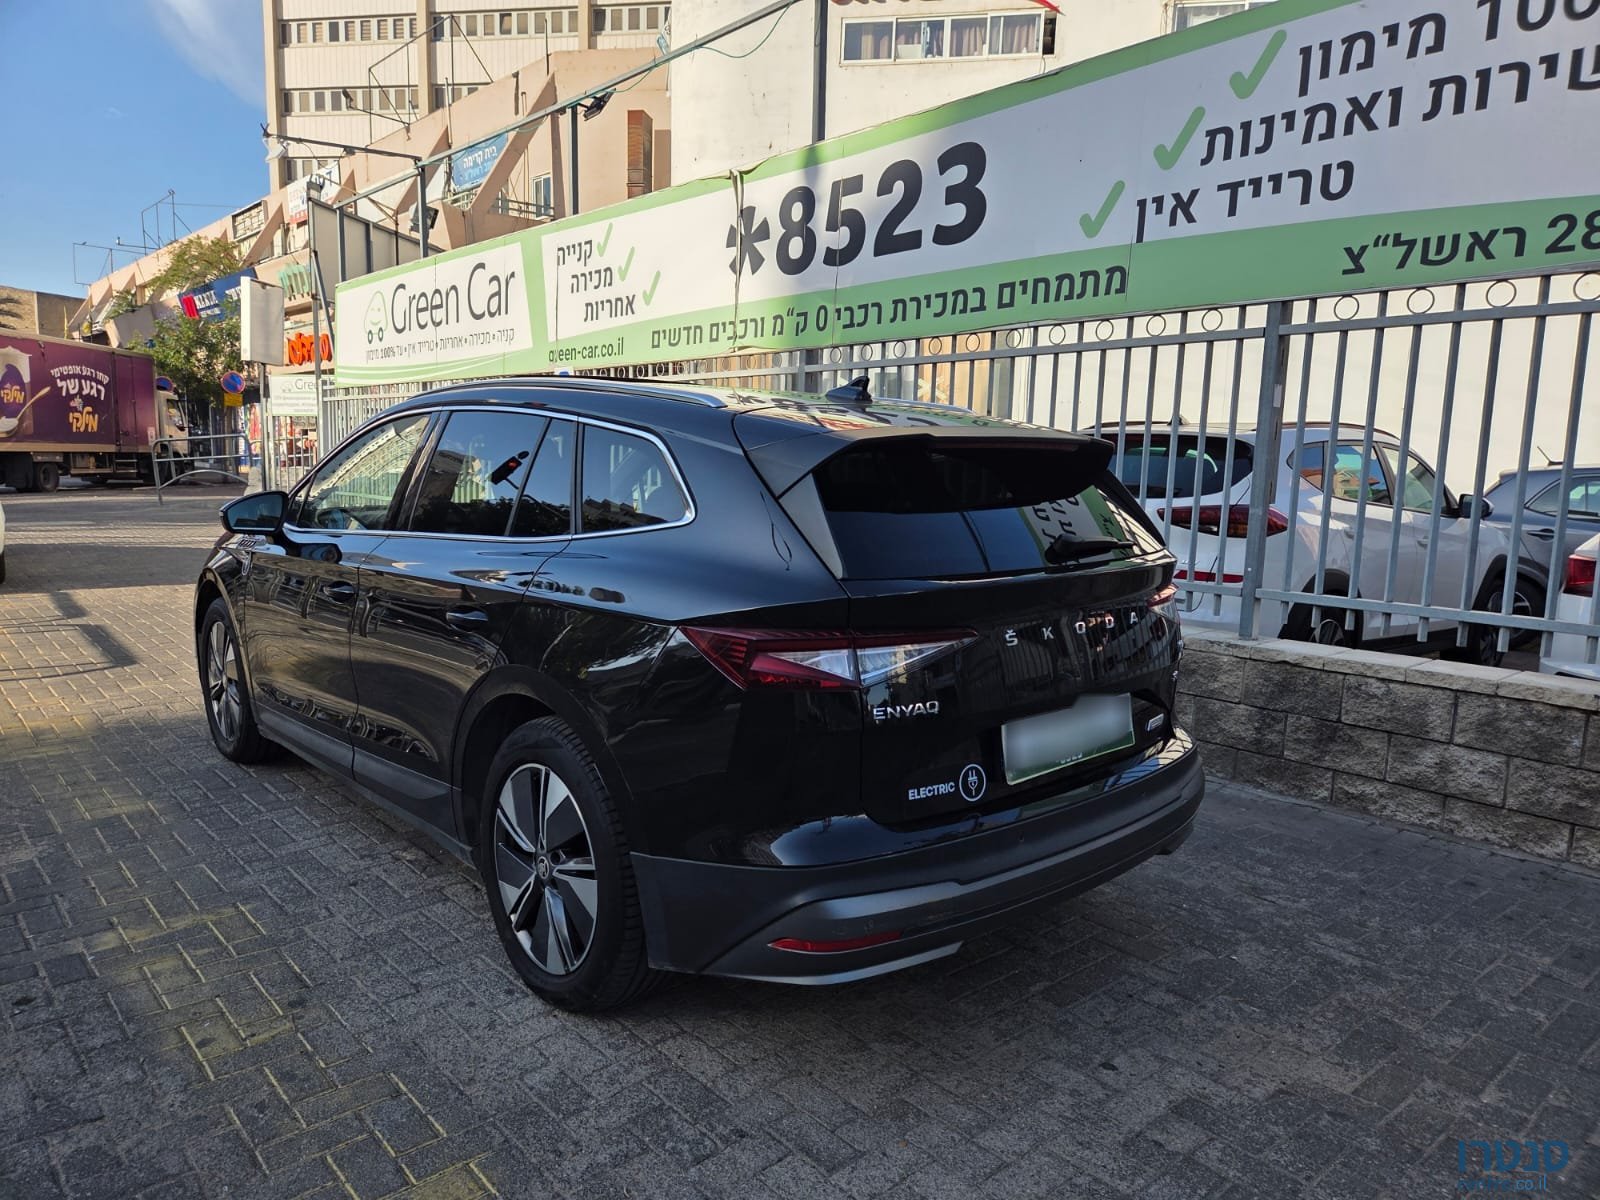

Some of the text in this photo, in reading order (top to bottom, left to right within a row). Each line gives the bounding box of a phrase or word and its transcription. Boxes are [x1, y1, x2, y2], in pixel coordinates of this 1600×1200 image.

[1297, 12, 1447, 97] מימון
[1200, 86, 1402, 166] ואמינות
[1135, 159, 1355, 244] טרייד אין
[557, 239, 593, 267] קנייה
[570, 266, 613, 294] מכירה
[997, 265, 1128, 310] מתמחים
[391, 262, 516, 335] Green Car
[583, 294, 636, 323] אחריות
[890, 286, 987, 324] במכירת
[709, 316, 766, 343] ורכבים
[815, 304, 828, 332] 0
[834, 301, 883, 330] רכבי
[440, 336, 463, 351] אחריות
[469, 331, 491, 347] מכירה
[496, 328, 515, 346] קניה
[651, 324, 703, 349] חדשים
[56, 378, 105, 400] רגע של
[69, 406, 99, 433] מילקי
[1005, 610, 1140, 647] ŠKODA
[873, 700, 940, 721] ENYAQ
[908, 781, 956, 801] ELECTRIC
